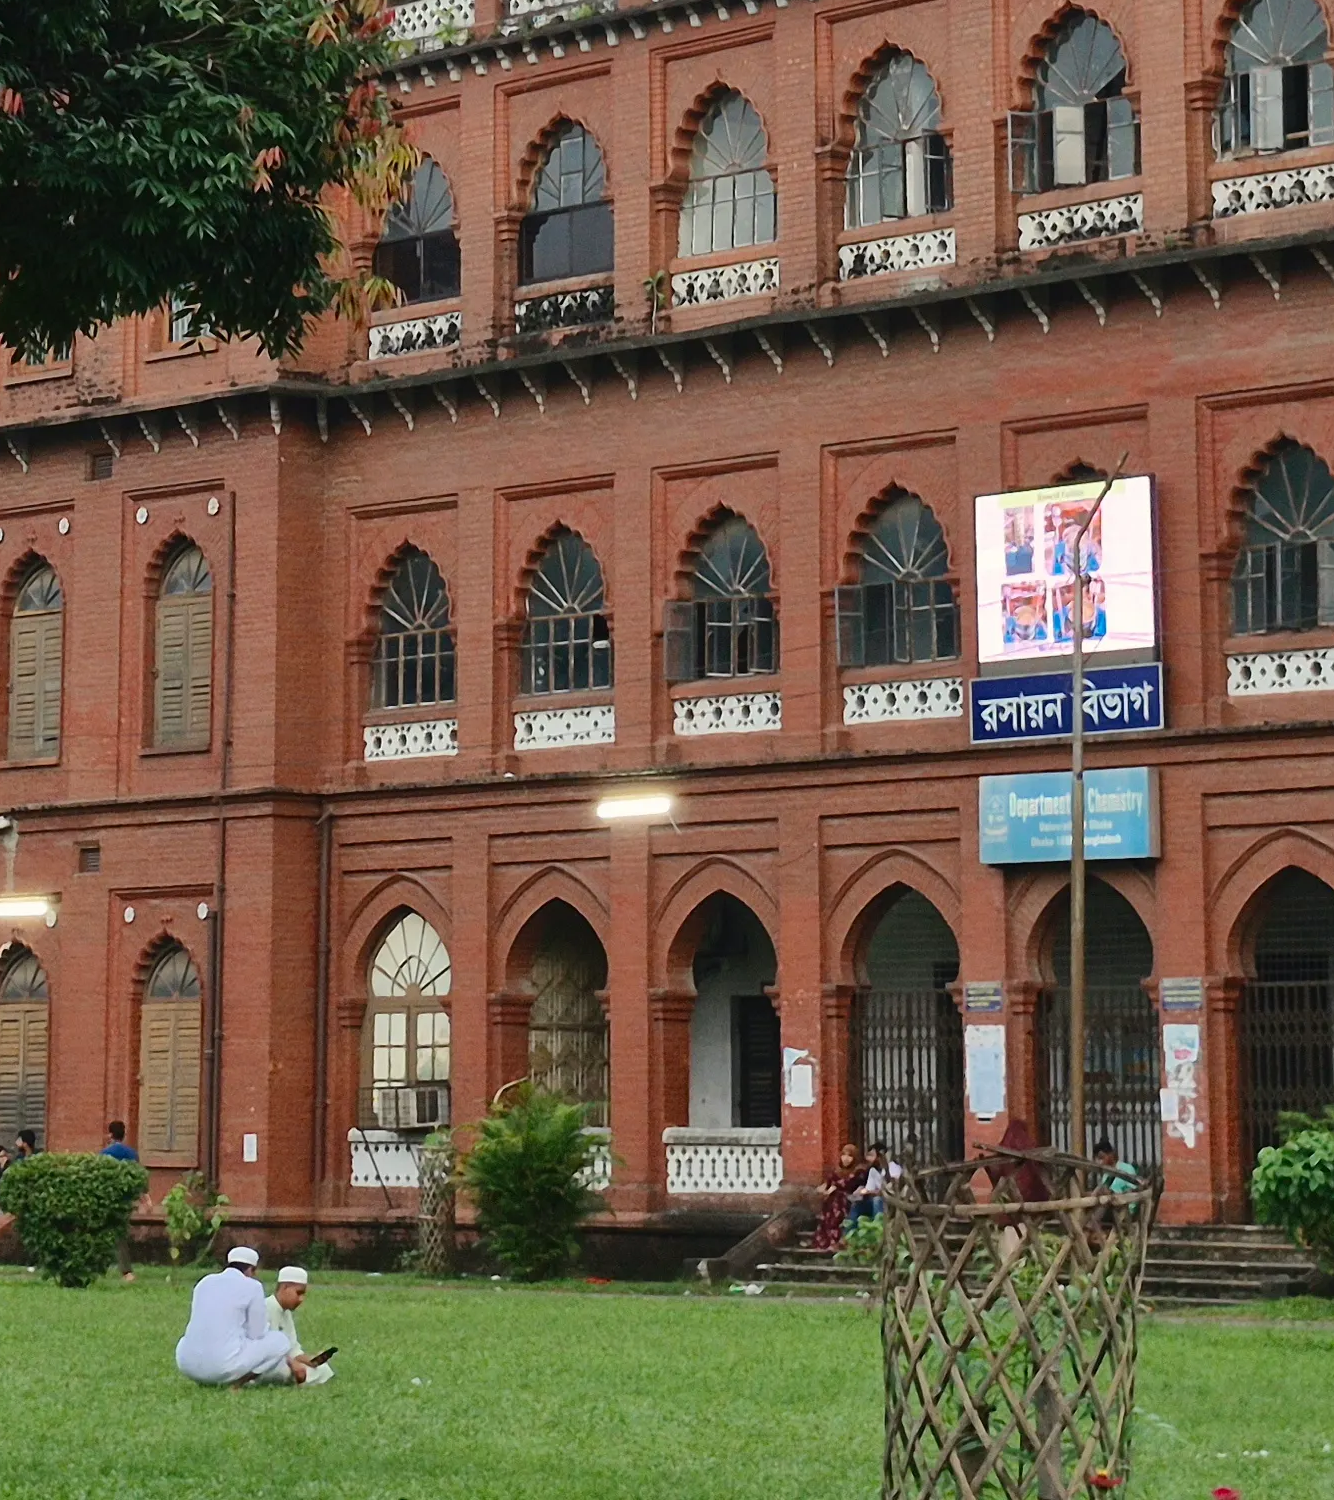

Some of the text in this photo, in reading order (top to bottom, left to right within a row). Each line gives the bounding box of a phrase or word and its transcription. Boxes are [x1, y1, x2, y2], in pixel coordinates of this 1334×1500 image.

[978, 691, 1067, 733] রসায়ন
[1008, 786, 1143, 823] Department Chemistry
